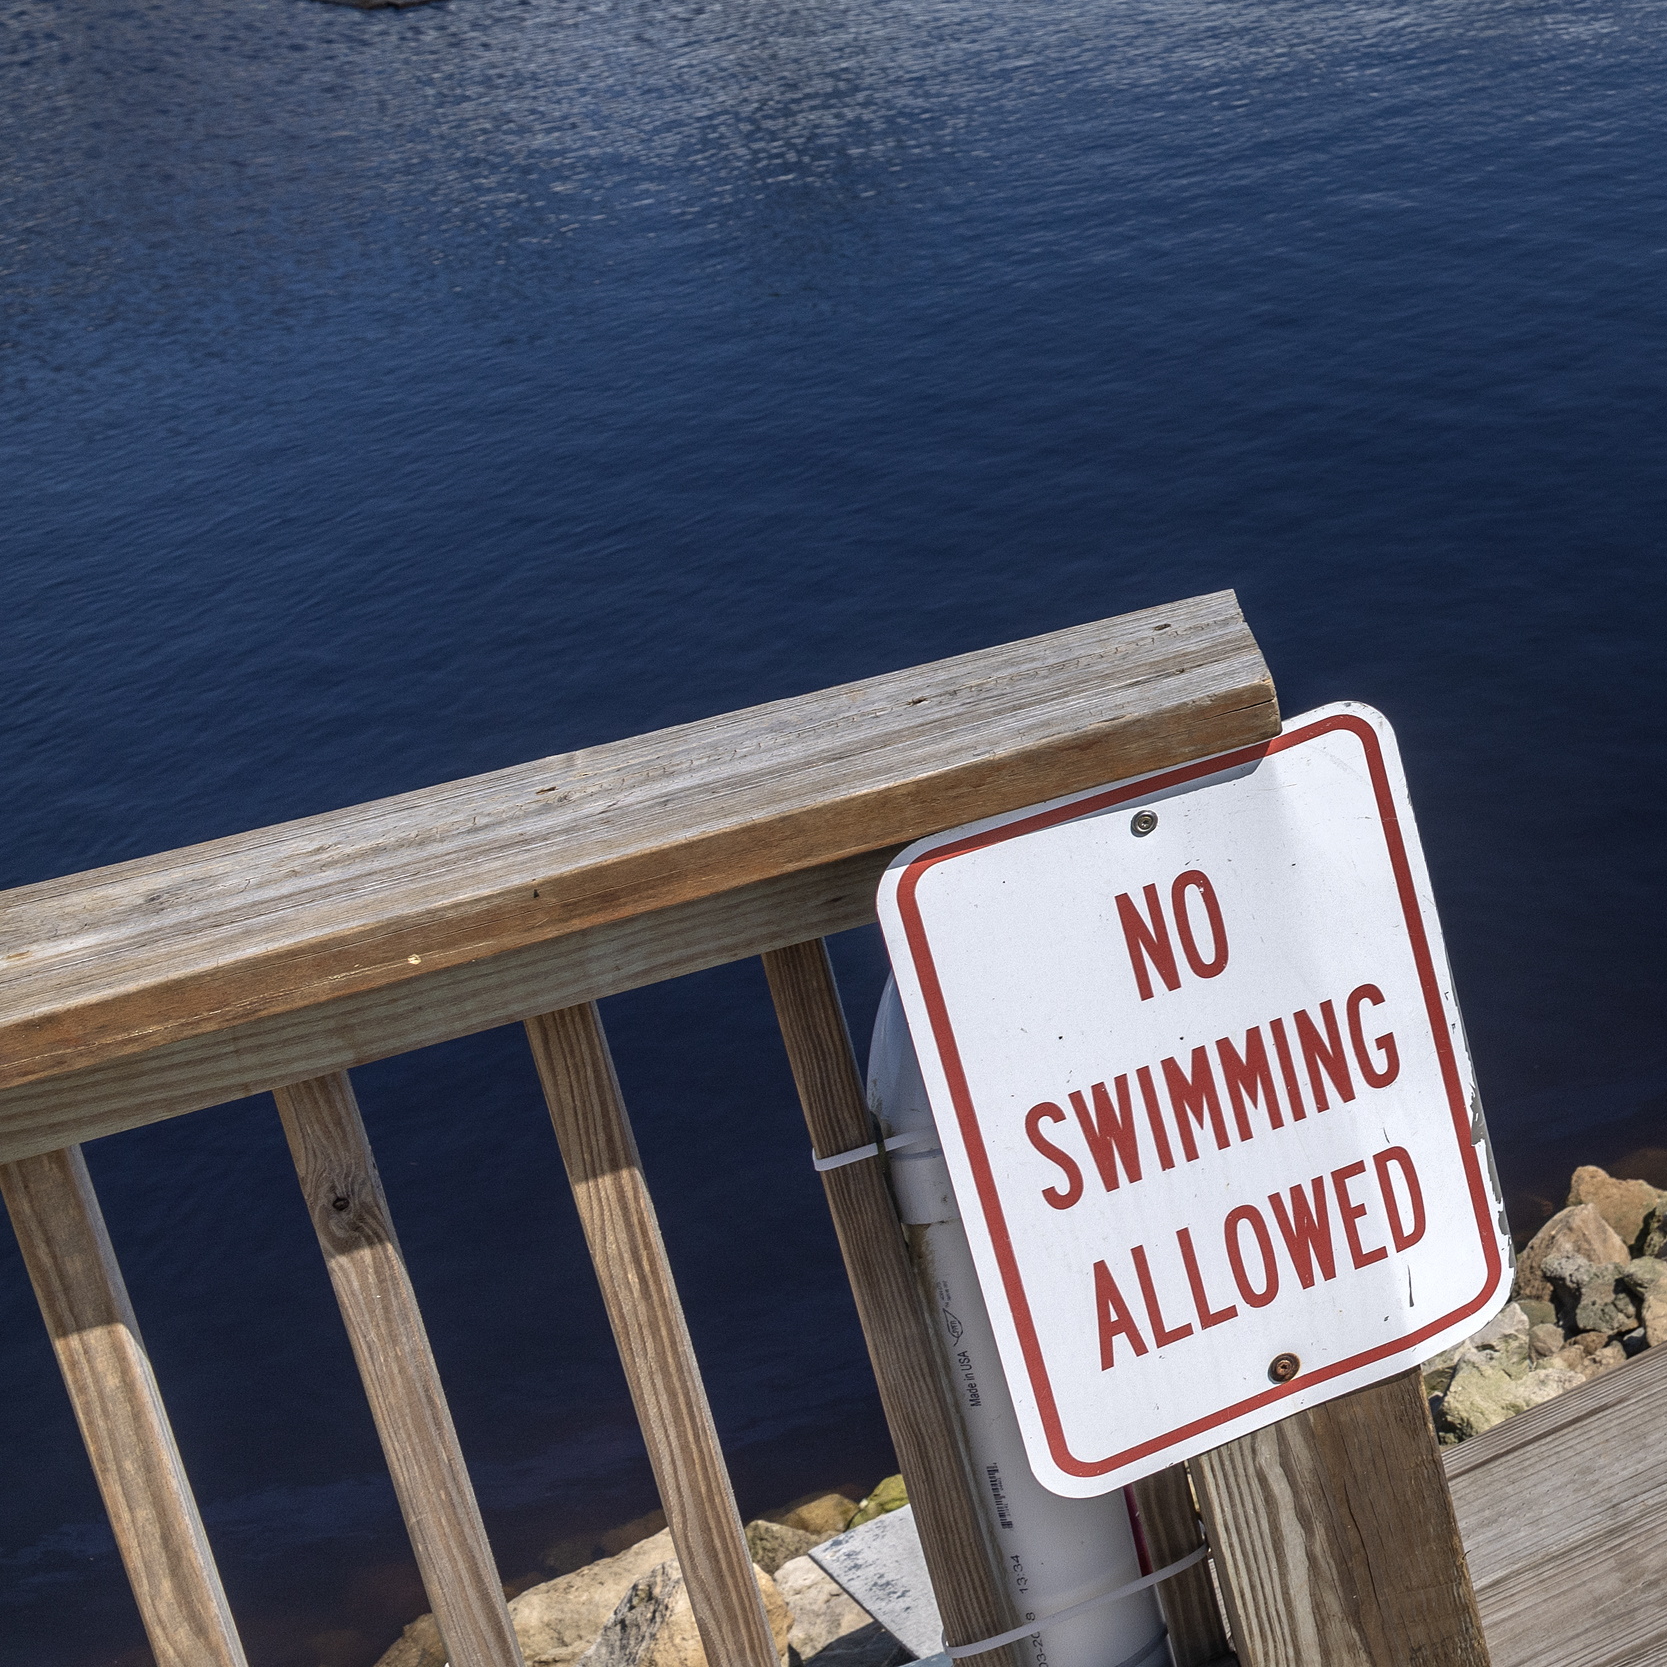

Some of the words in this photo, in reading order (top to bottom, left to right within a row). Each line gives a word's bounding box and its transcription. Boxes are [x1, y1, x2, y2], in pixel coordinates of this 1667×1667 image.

[1115, 870, 1228, 1000] NO
[1025, 984, 1399, 1210] SWIMMING
[1093, 1146, 1426, 1371] ALLOWED
[957, 1350, 972, 1371] USA
[964, 1372, 974, 1382] in
[967, 1383, 981, 1407] Made
[1011, 1555, 1028, 1593] 13:34
